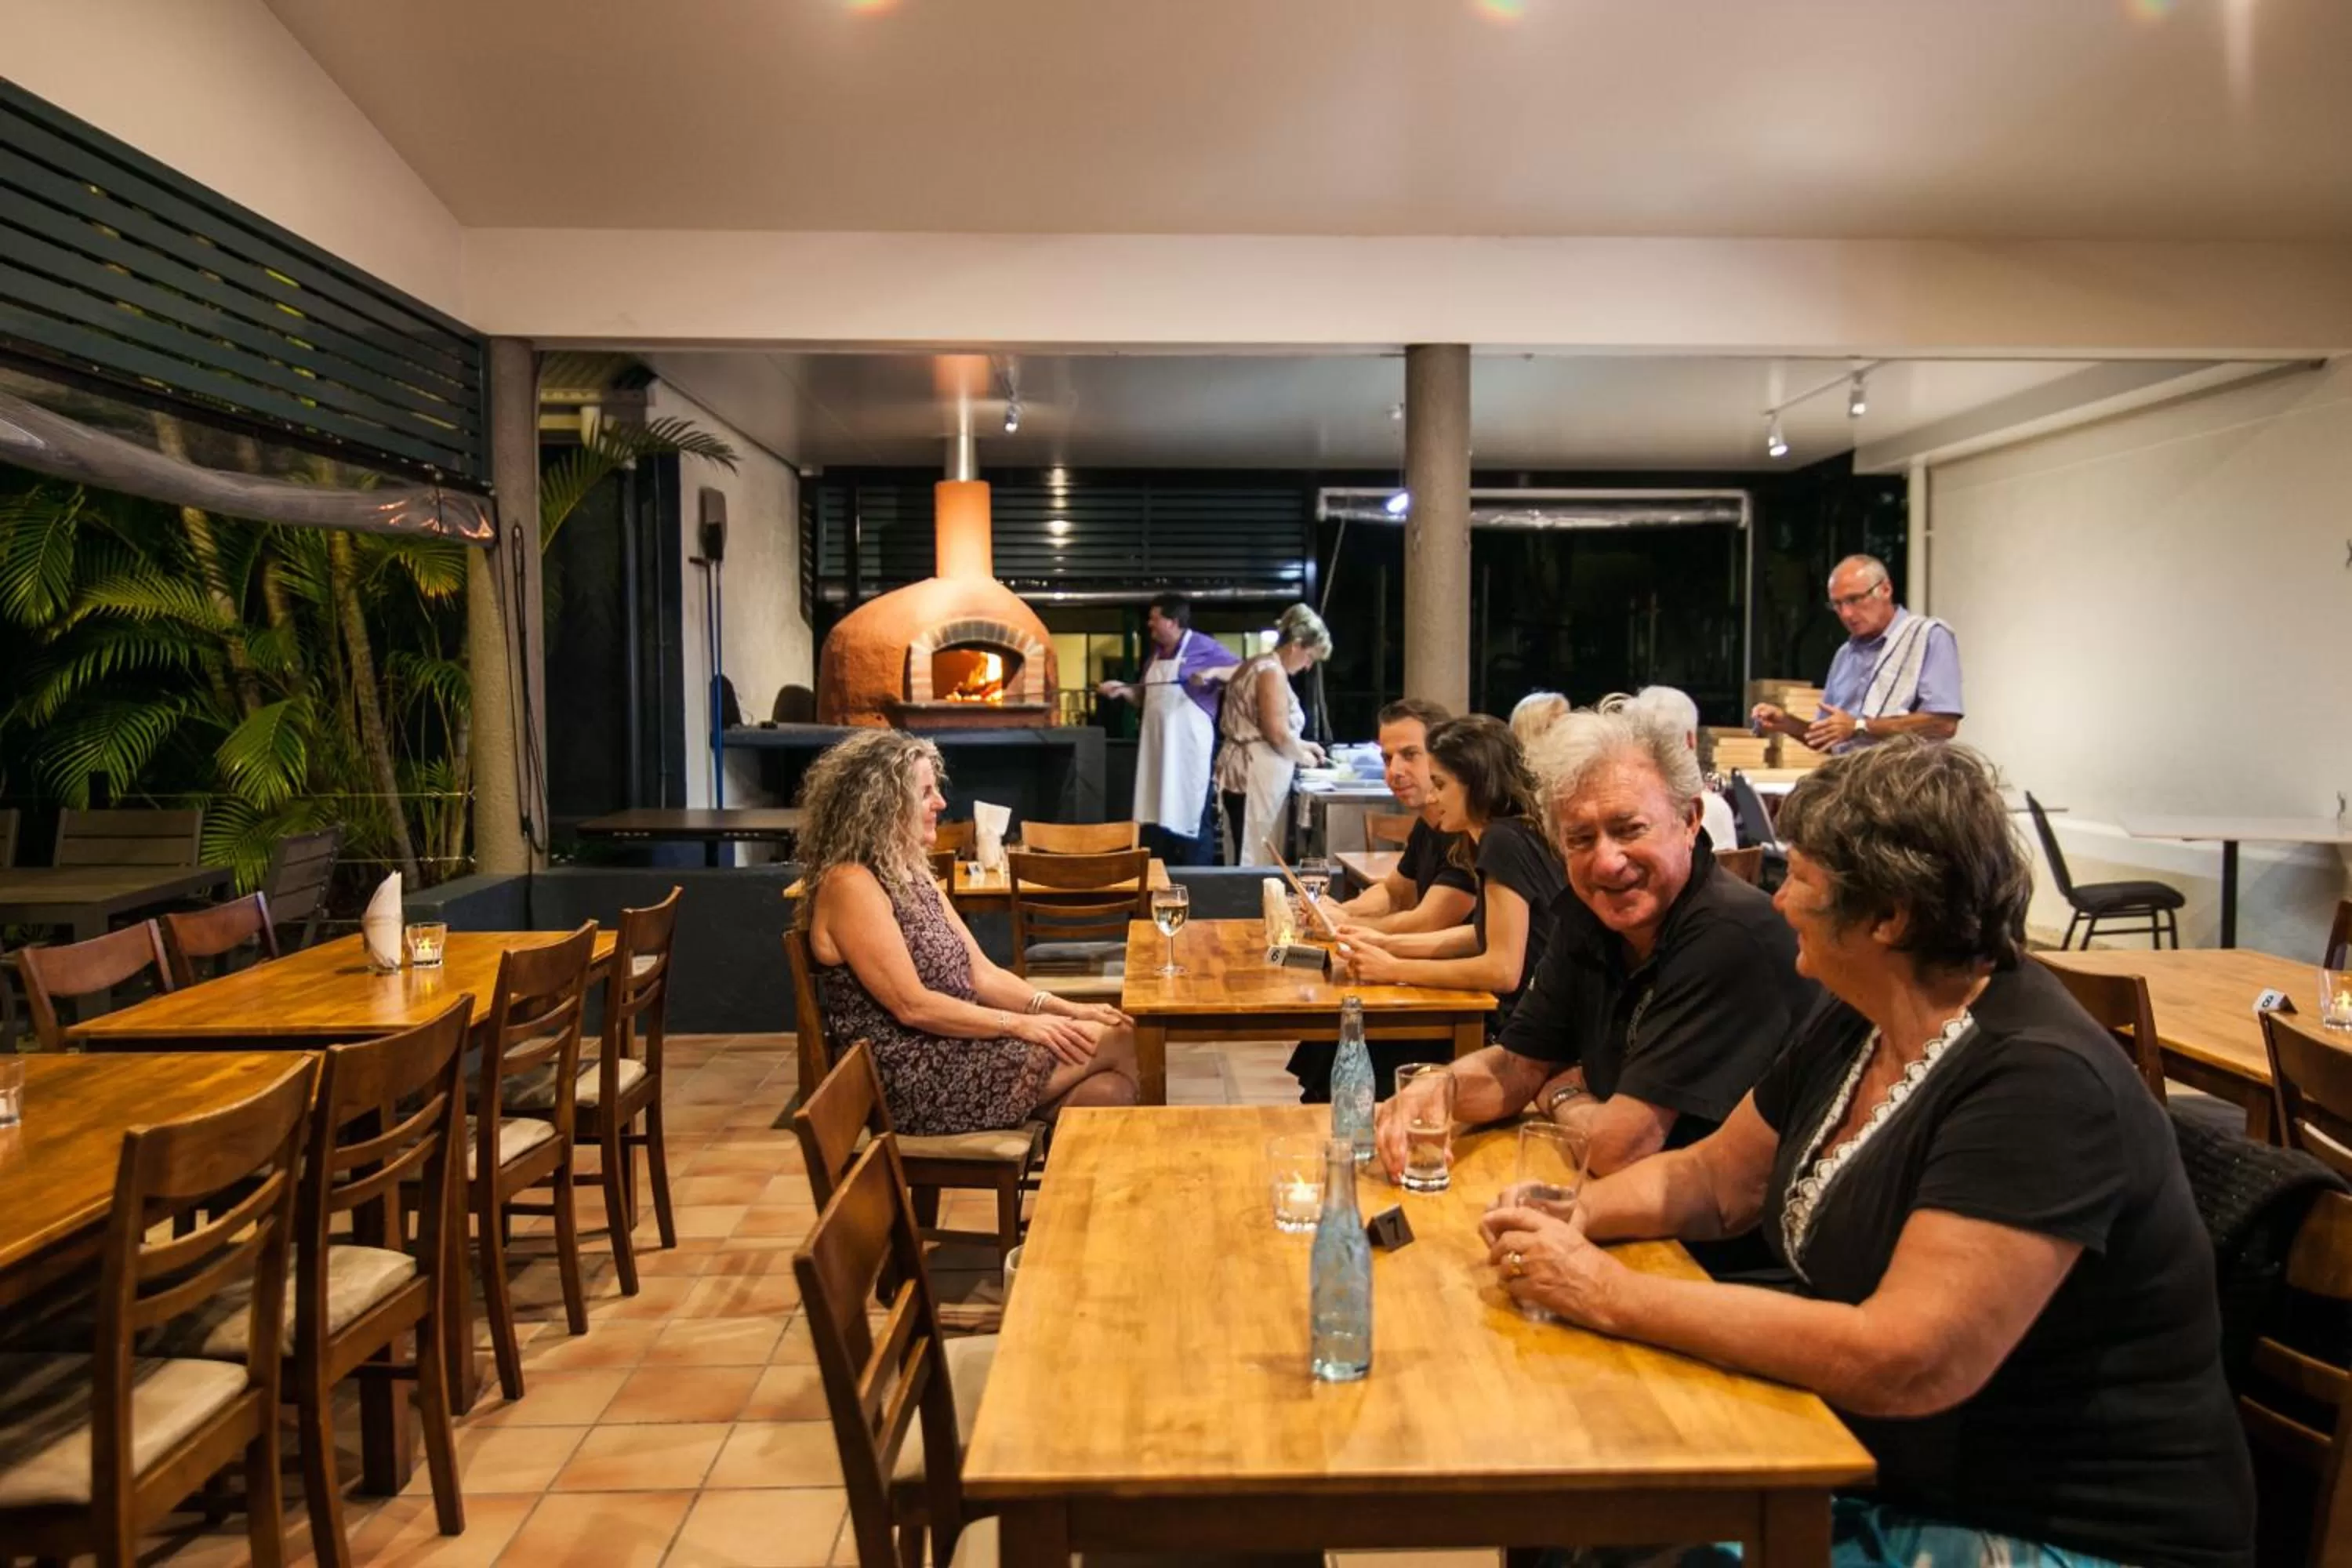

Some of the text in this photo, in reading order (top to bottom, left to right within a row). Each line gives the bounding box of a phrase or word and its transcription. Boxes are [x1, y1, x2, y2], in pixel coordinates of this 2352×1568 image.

[1271, 949, 1279, 962] 6
[2261, 994, 2274, 1007] 8
[1387, 1216, 1400, 1240] 7
